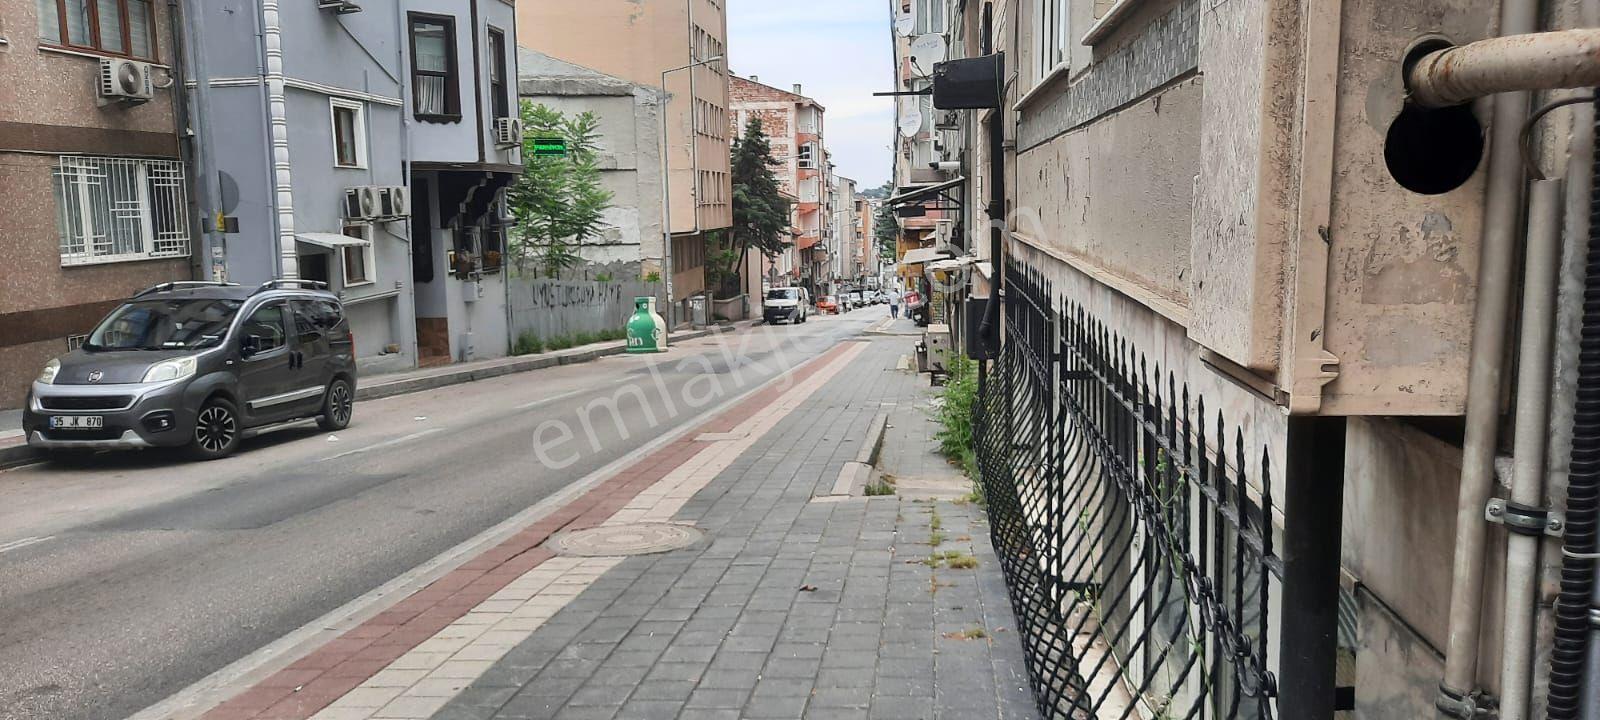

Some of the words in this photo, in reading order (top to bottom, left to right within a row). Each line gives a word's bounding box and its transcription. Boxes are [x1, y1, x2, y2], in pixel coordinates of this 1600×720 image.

[54, 416, 63, 426] 35
[70, 416, 79, 426] JK
[86, 416, 102, 426] 870
